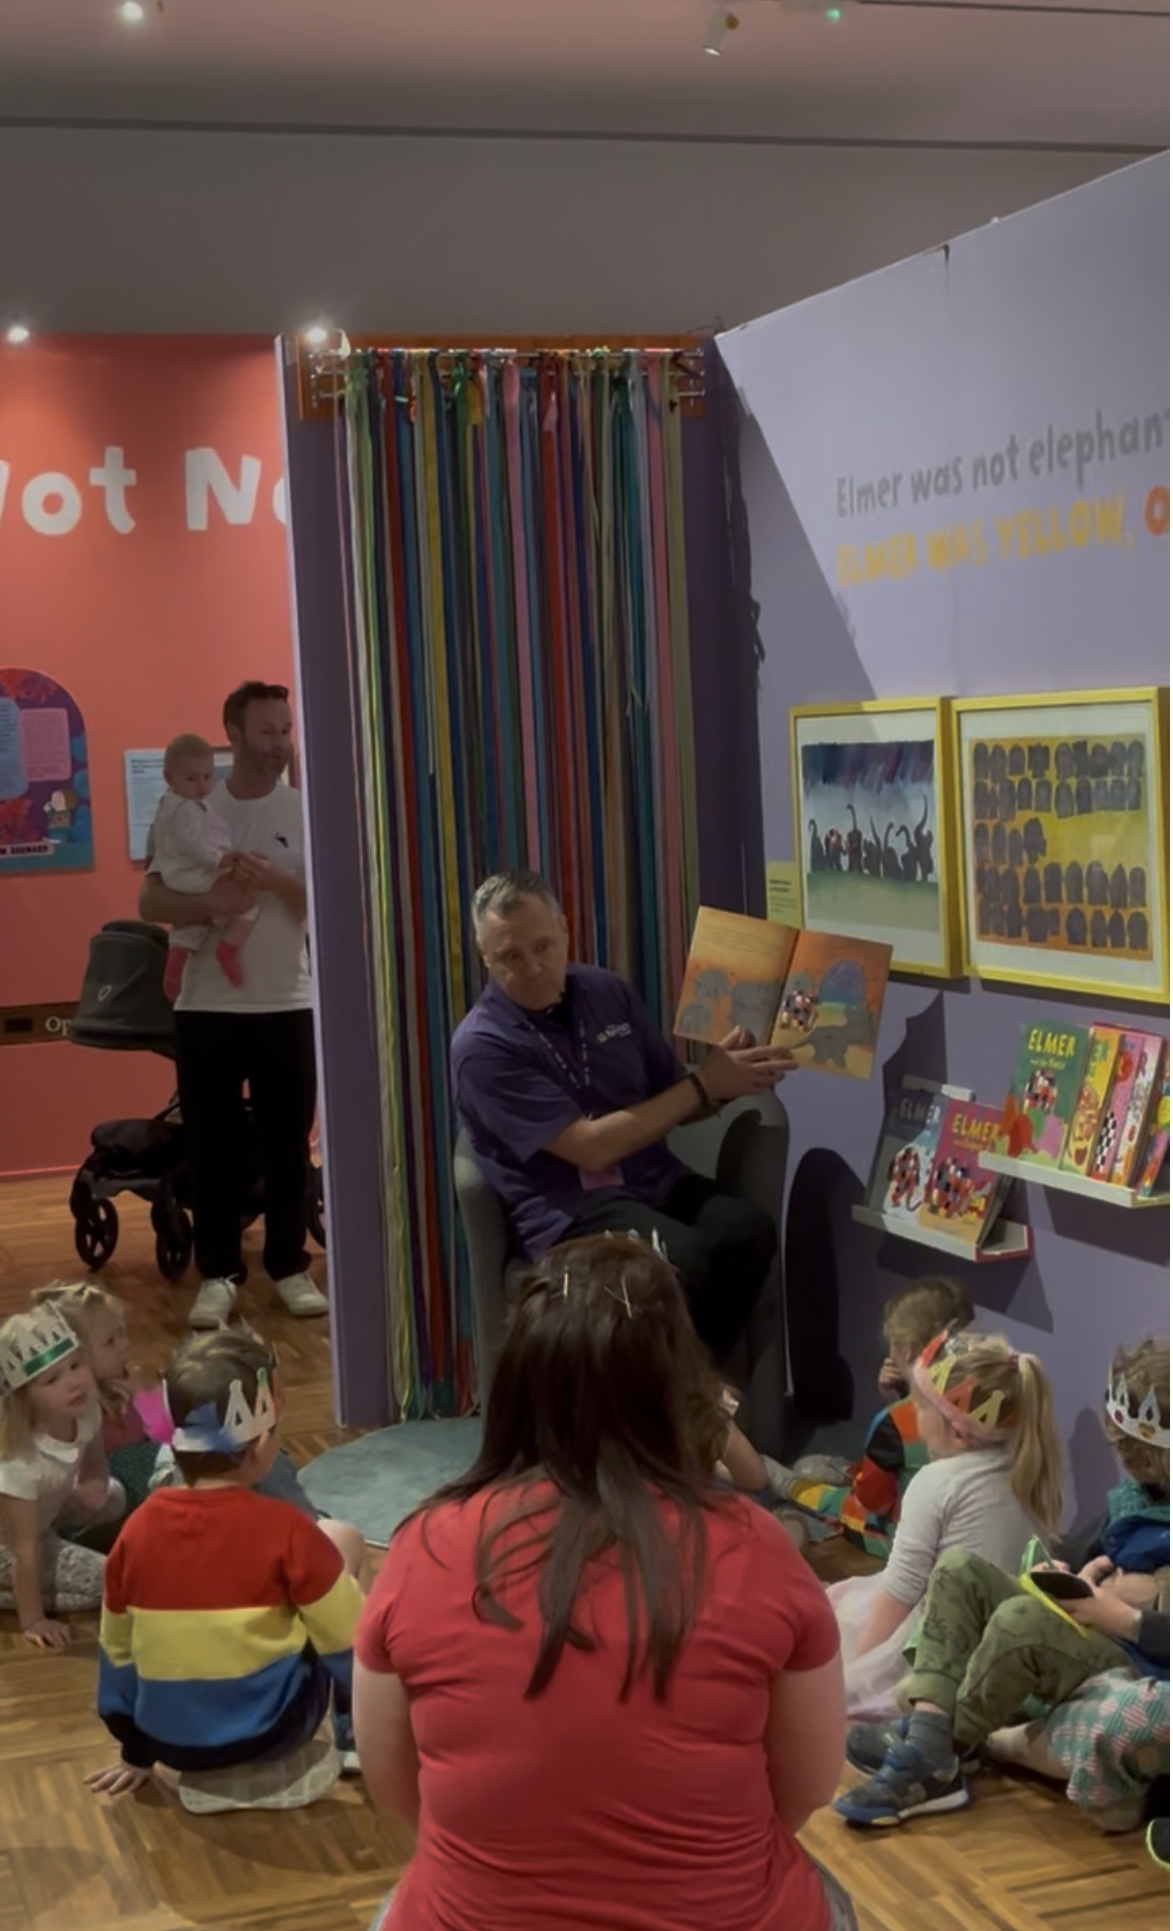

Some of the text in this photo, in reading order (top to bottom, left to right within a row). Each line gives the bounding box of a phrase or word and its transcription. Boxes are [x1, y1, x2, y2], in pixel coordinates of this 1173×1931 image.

[185, 446, 287, 531] N
[837, 472, 902, 519] Elmer
[911, 455, 962, 504] was
[972, 433, 1019, 491] not
[836, 532, 917, 588] ELMER
[925, 515, 987, 573] WAS
[1144, 484, 1170, 536] O
[1027, 1028, 1077, 1058] ELMER
[951, 1112, 1001, 1143] ELMER
